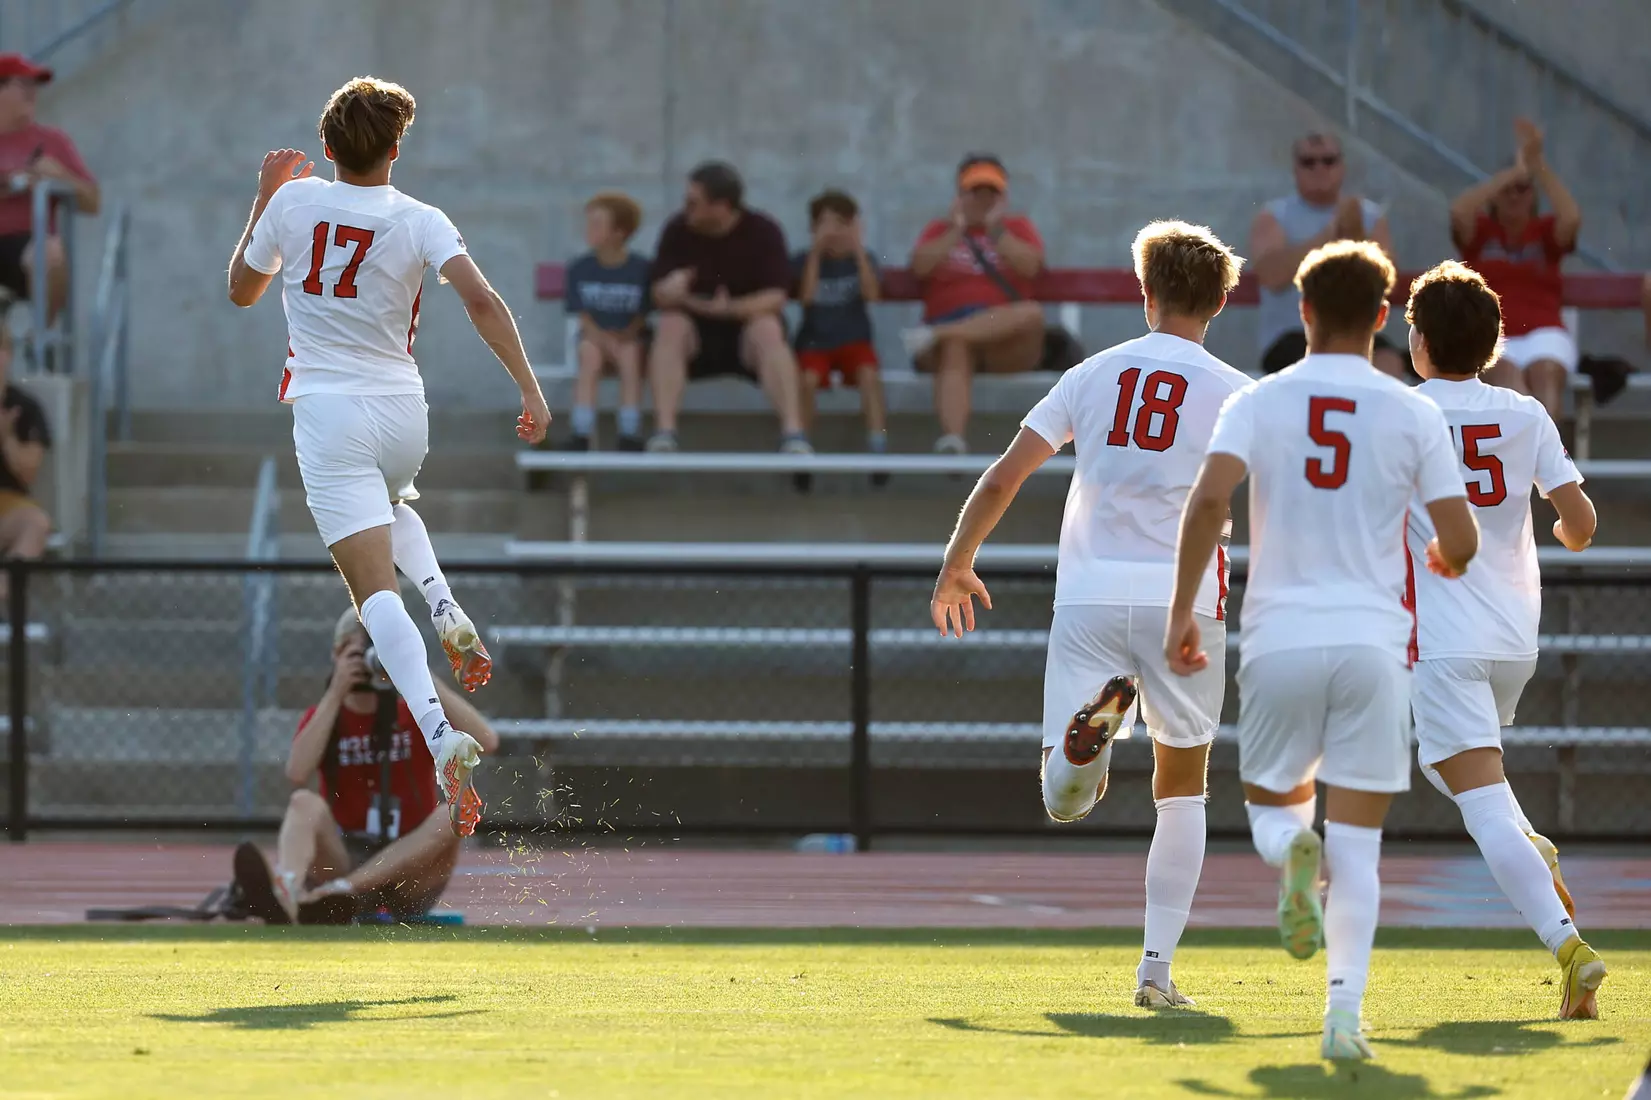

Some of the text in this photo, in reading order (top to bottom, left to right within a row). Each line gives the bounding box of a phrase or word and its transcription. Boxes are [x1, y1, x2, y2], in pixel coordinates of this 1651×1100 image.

[302, 220, 376, 299] 17
[1106, 367, 1189, 452] 18
[1304, 396, 1357, 490] 5
[1449, 423, 1507, 508] 5
